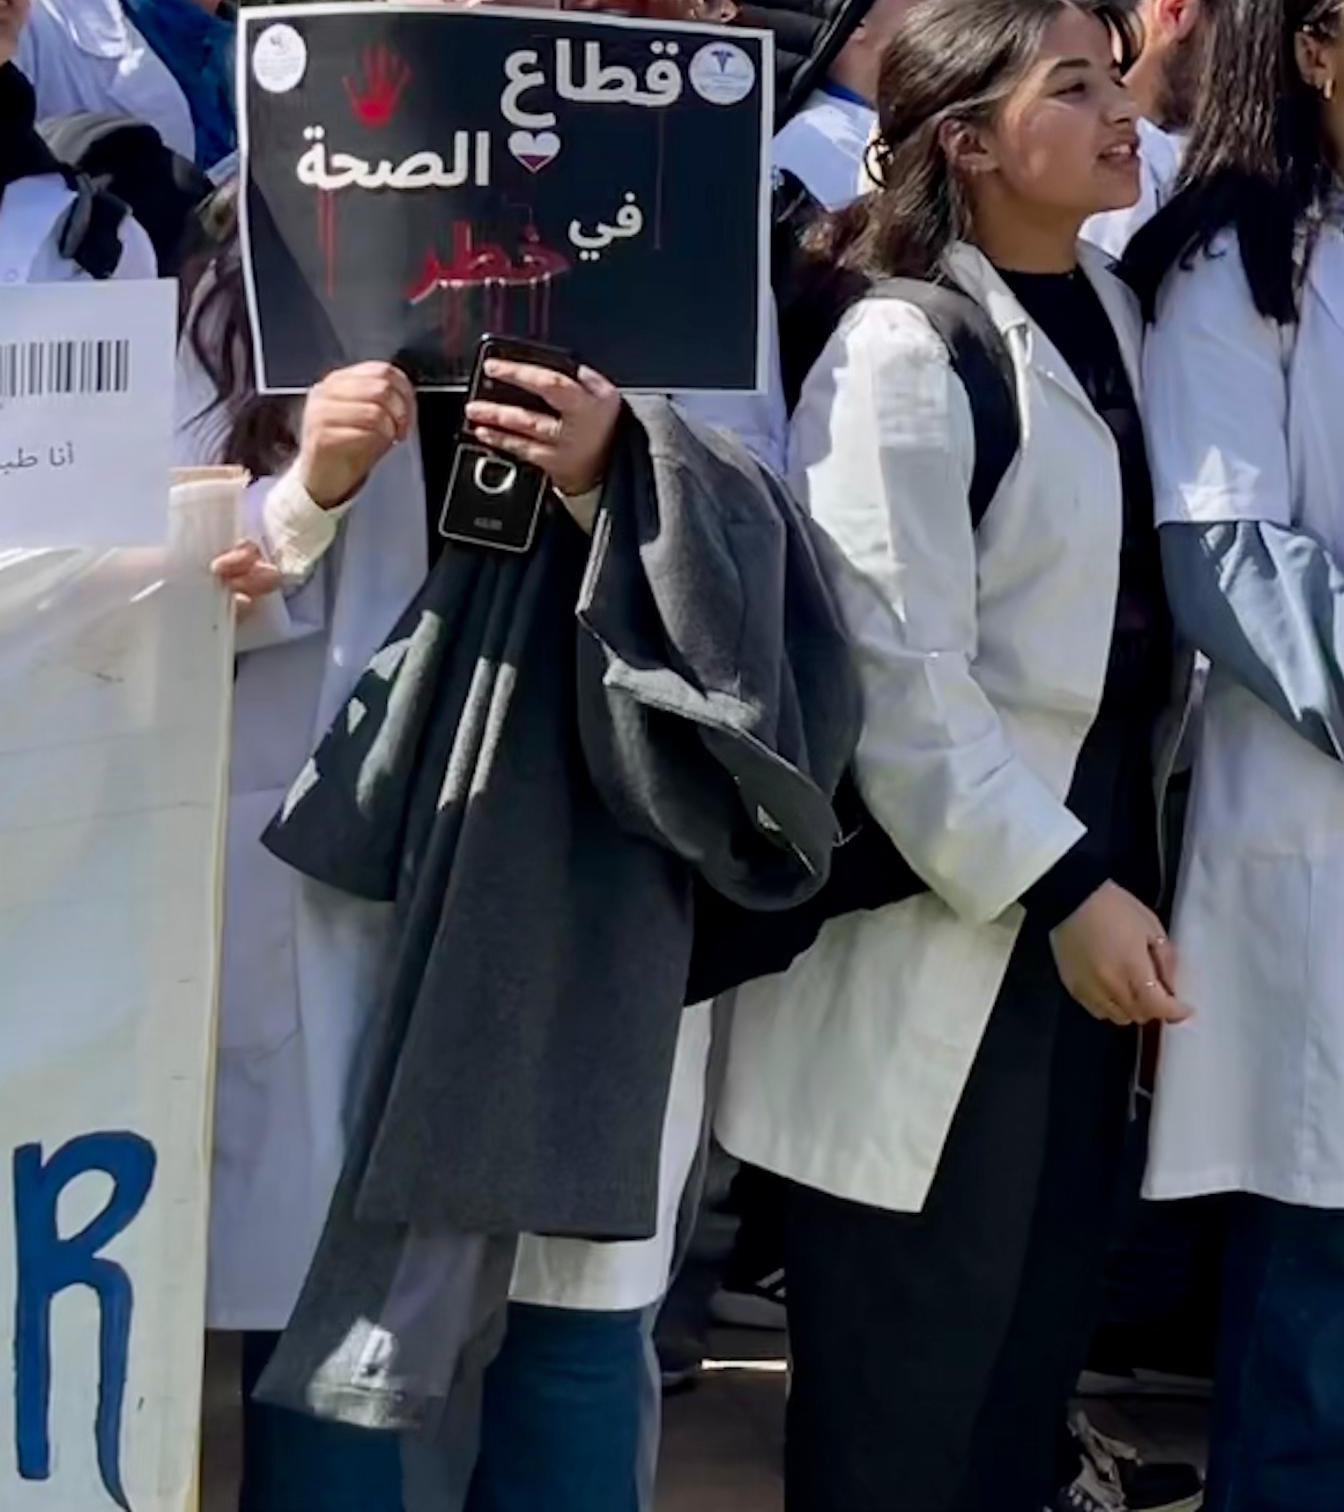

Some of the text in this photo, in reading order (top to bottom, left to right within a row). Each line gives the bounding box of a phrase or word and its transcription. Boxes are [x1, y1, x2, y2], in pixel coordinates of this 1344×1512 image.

[500, 39, 685, 129] قطاع
[296, 125, 491, 191] الصحة
[407, 191, 644, 304] في خطر
[48, 440, 75, 467] أنا
[13, 1130, 158, 1512] R
